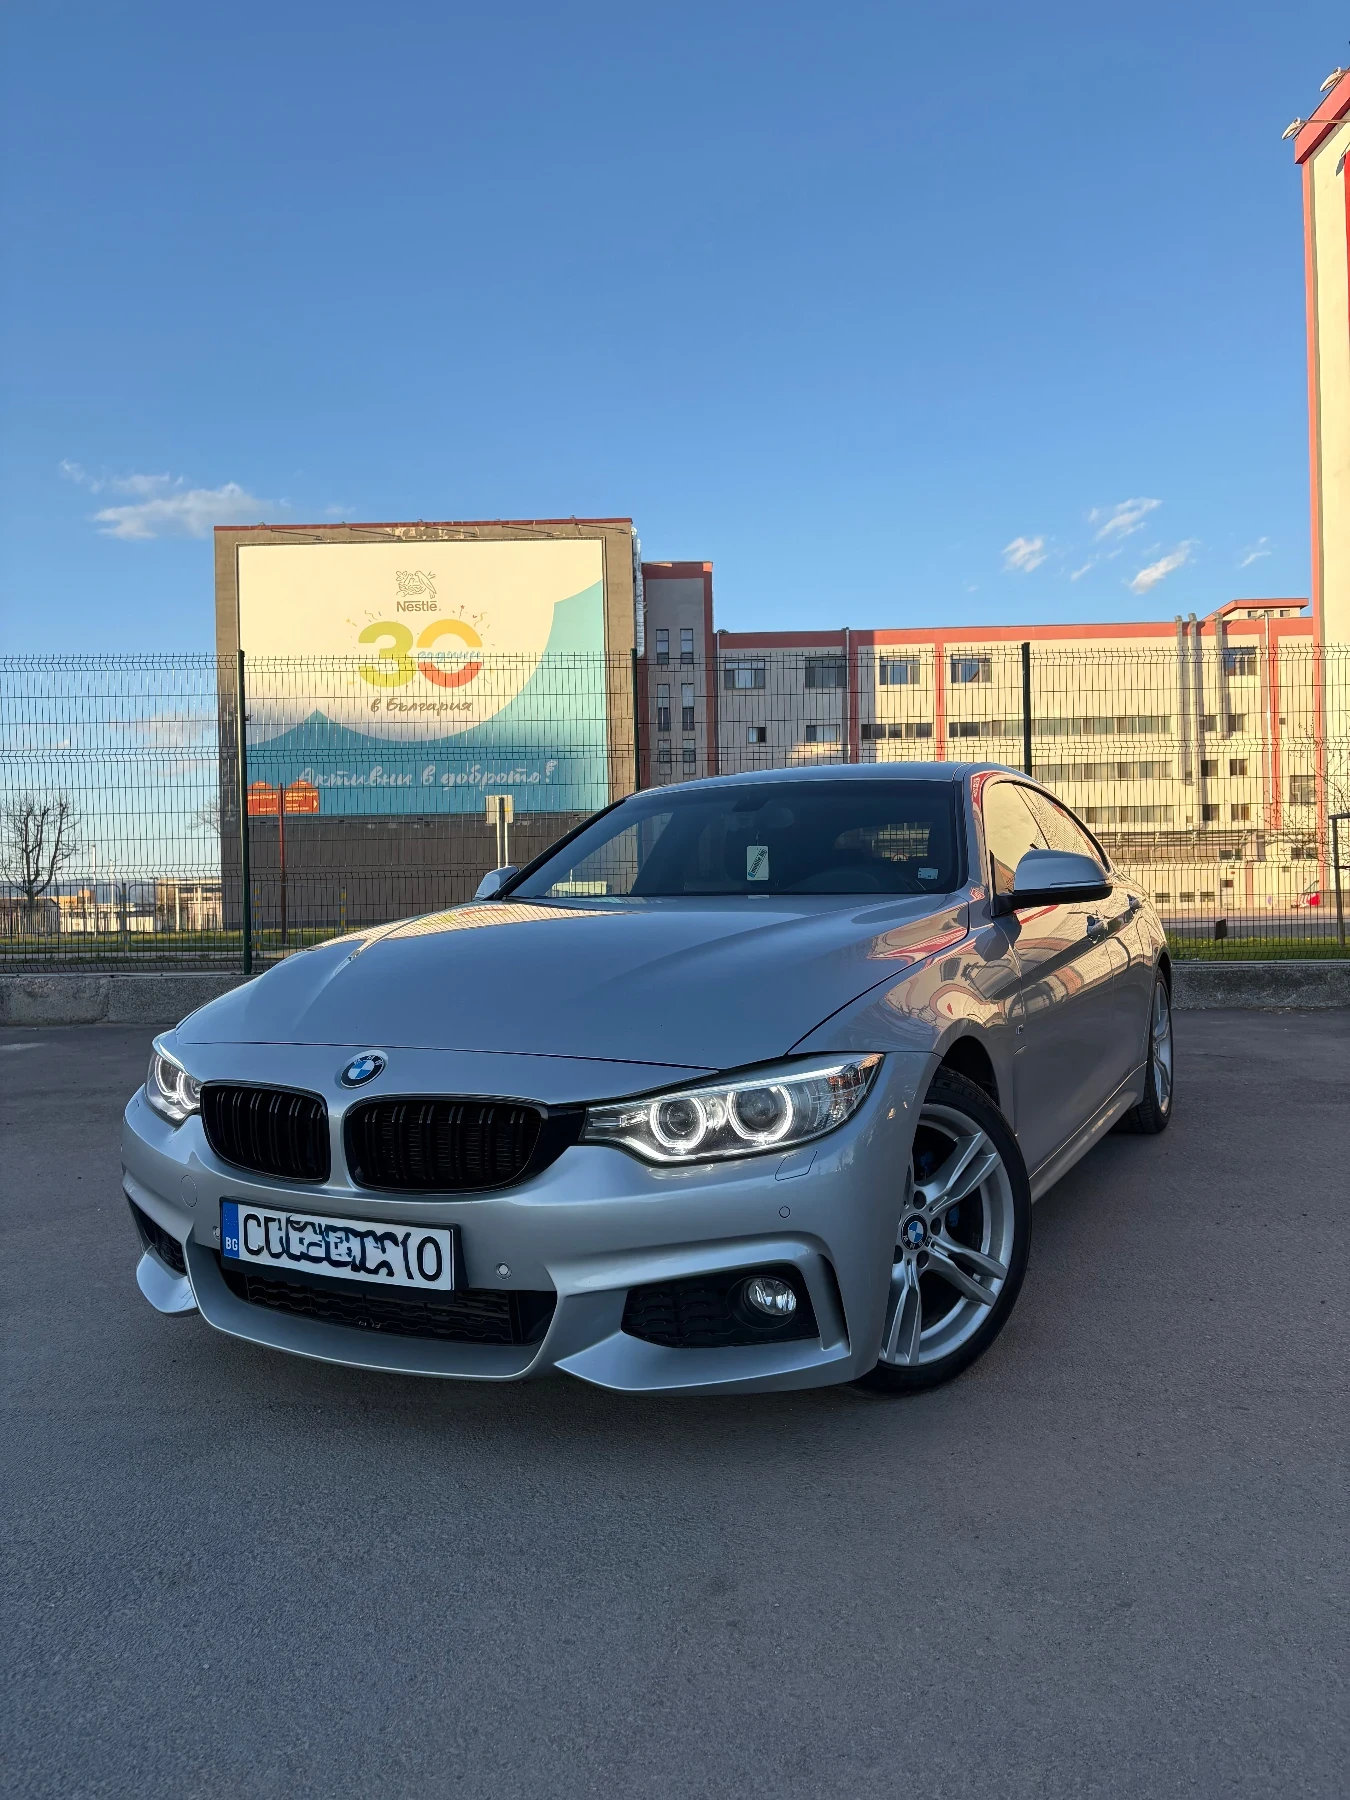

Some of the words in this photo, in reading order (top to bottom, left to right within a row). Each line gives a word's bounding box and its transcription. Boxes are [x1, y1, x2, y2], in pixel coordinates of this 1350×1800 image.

[397, 600, 438, 612] Nestlé
[358, 618, 483, 688] 30
[371, 697, 381, 712] в
[386, 697, 473, 716] България
[296, 765, 413, 788] Активни
[422, 765, 436, 786] в
[225, 1236, 238, 1251] BG
